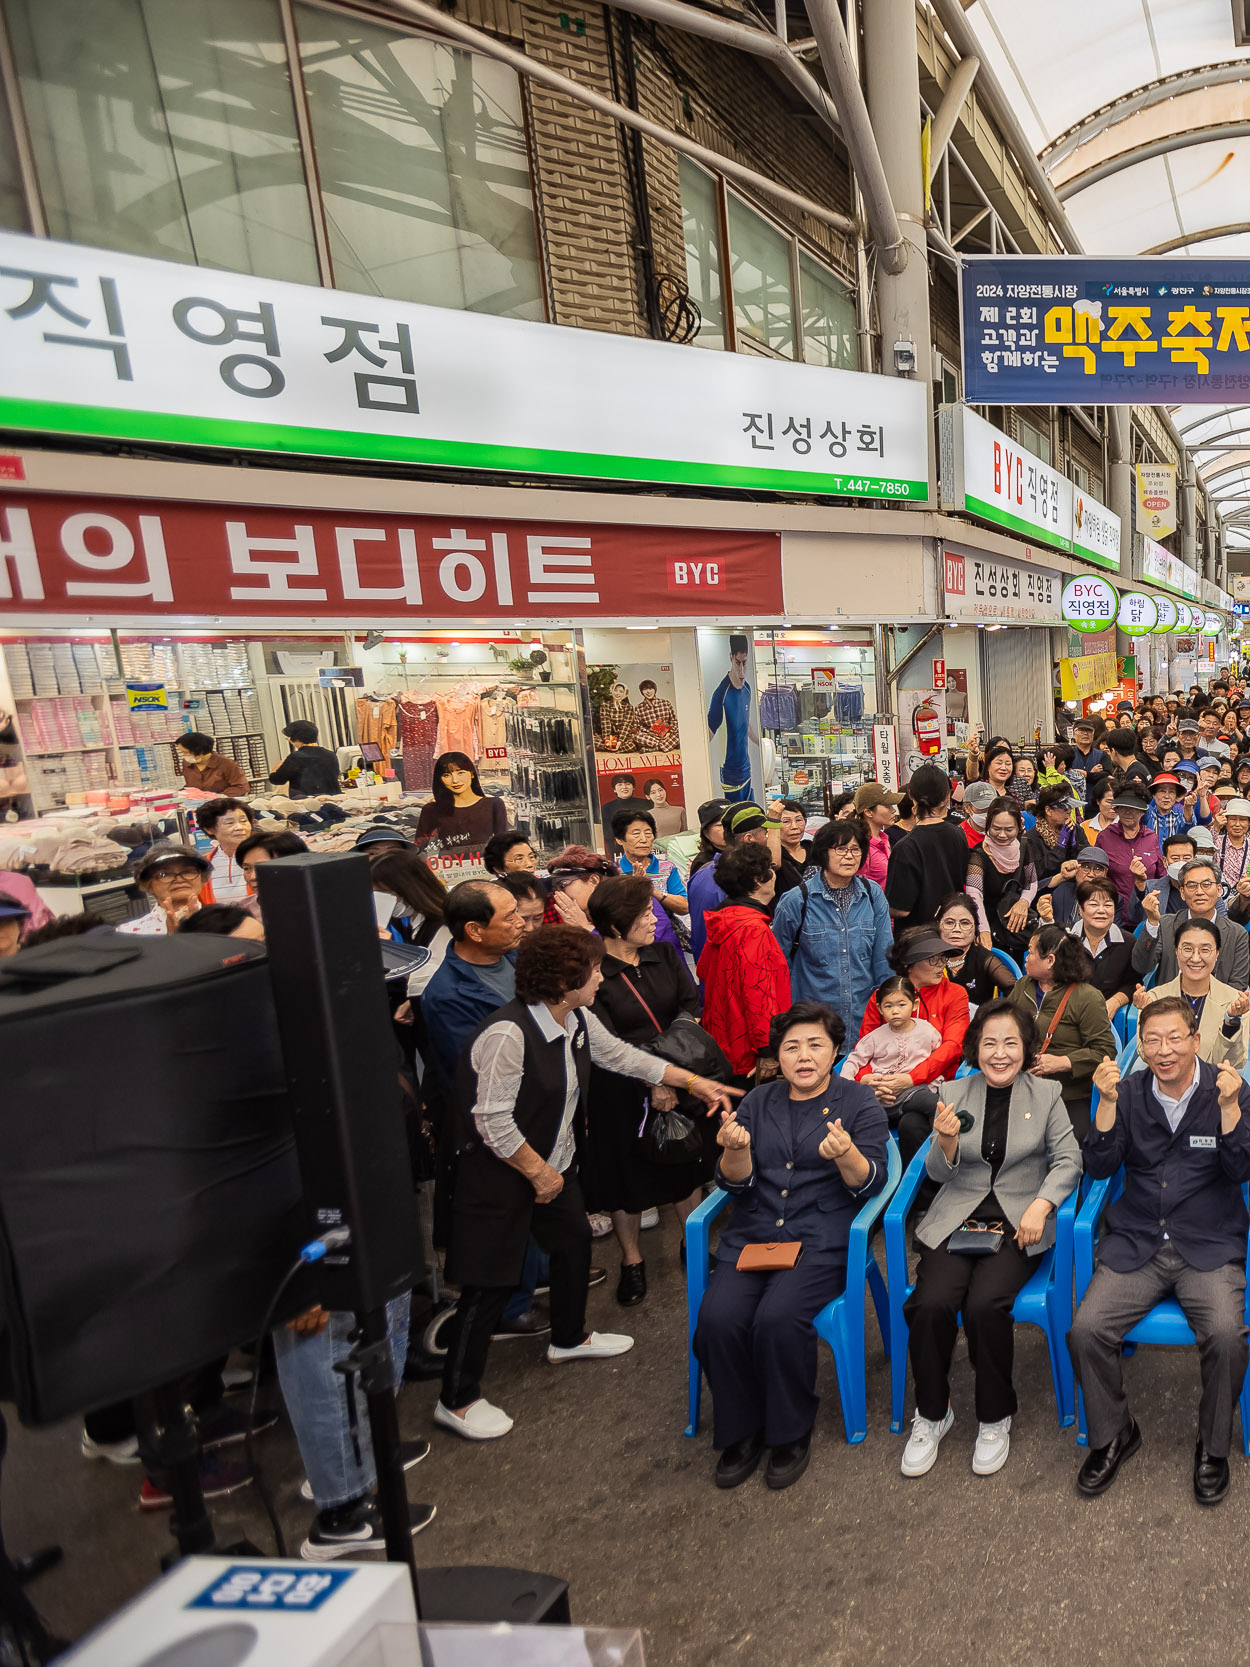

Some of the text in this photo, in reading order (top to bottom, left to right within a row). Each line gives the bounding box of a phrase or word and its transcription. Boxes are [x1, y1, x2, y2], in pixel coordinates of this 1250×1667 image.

[976, 284, 1078, 298] 2024 자양전통시장
[1114, 286, 1148, 296] 서울특별시
[1171, 286, 1194, 295] 광진구
[980, 306, 998, 323] 제
[0, 268, 420, 414] 직영점
[981, 329, 1038, 350] 고객과
[1044, 304, 1158, 374] 맥주
[981, 351, 1059, 373] 함께하는
[742, 412, 886, 460] 진성상회
[833, 477, 910, 496] T.447-7850
[994, 440, 1059, 524] BYC 직영점
[225, 521, 600, 606] 보디히트
[674, 561, 719, 585] BYC
[947, 559, 1052, 603] BYC 진성상회 직영점
[1074, 584, 1103, 597] BYC
[1068, 600, 1110, 616] 직영점
[1129, 598, 1145, 608] 하림
[1131, 609, 1143, 622] 닭
[488, 748, 505, 758] BYC
[596, 753, 681, 770] HOME WEAR
[879, 730, 892, 783] 타월 맞춤
[212, 1572, 334, 1604] 응모함
